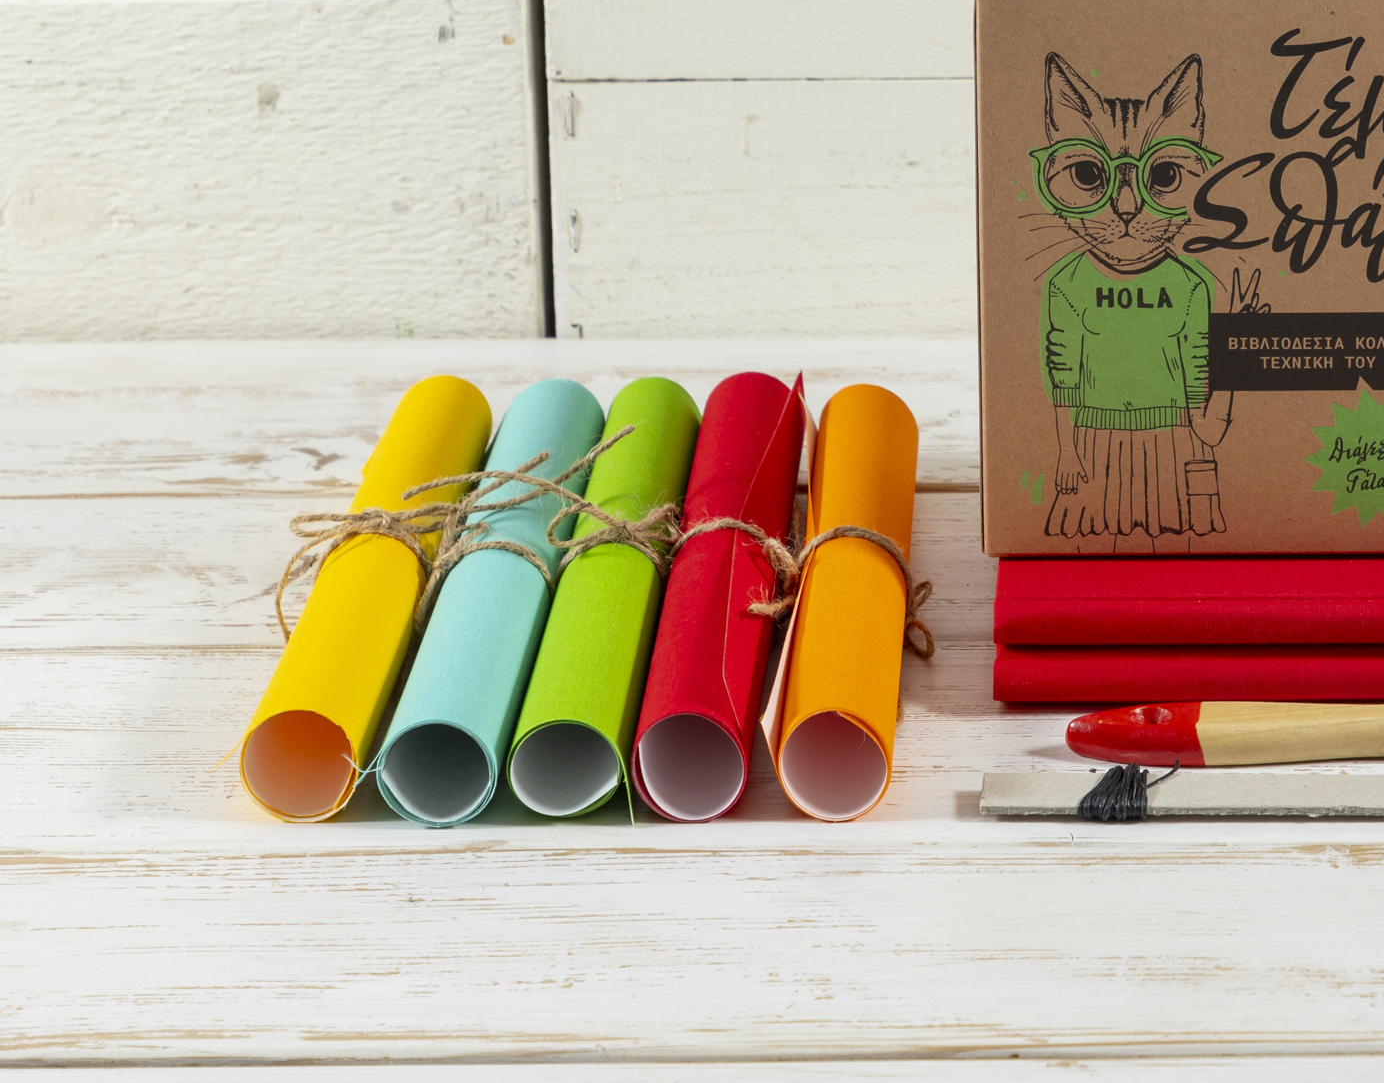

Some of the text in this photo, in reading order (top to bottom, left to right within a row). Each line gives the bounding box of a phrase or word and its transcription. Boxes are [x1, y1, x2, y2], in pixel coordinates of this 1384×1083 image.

[1096, 286, 1173, 309] HOLA
[1228, 336, 1345, 351] ΒΙΒΛΙΟΔΕΣΙΑ
[1259, 355, 1334, 370] ΤΕΧΝΙΚΗ
[1344, 355, 1376, 370] ΤΟΥ
